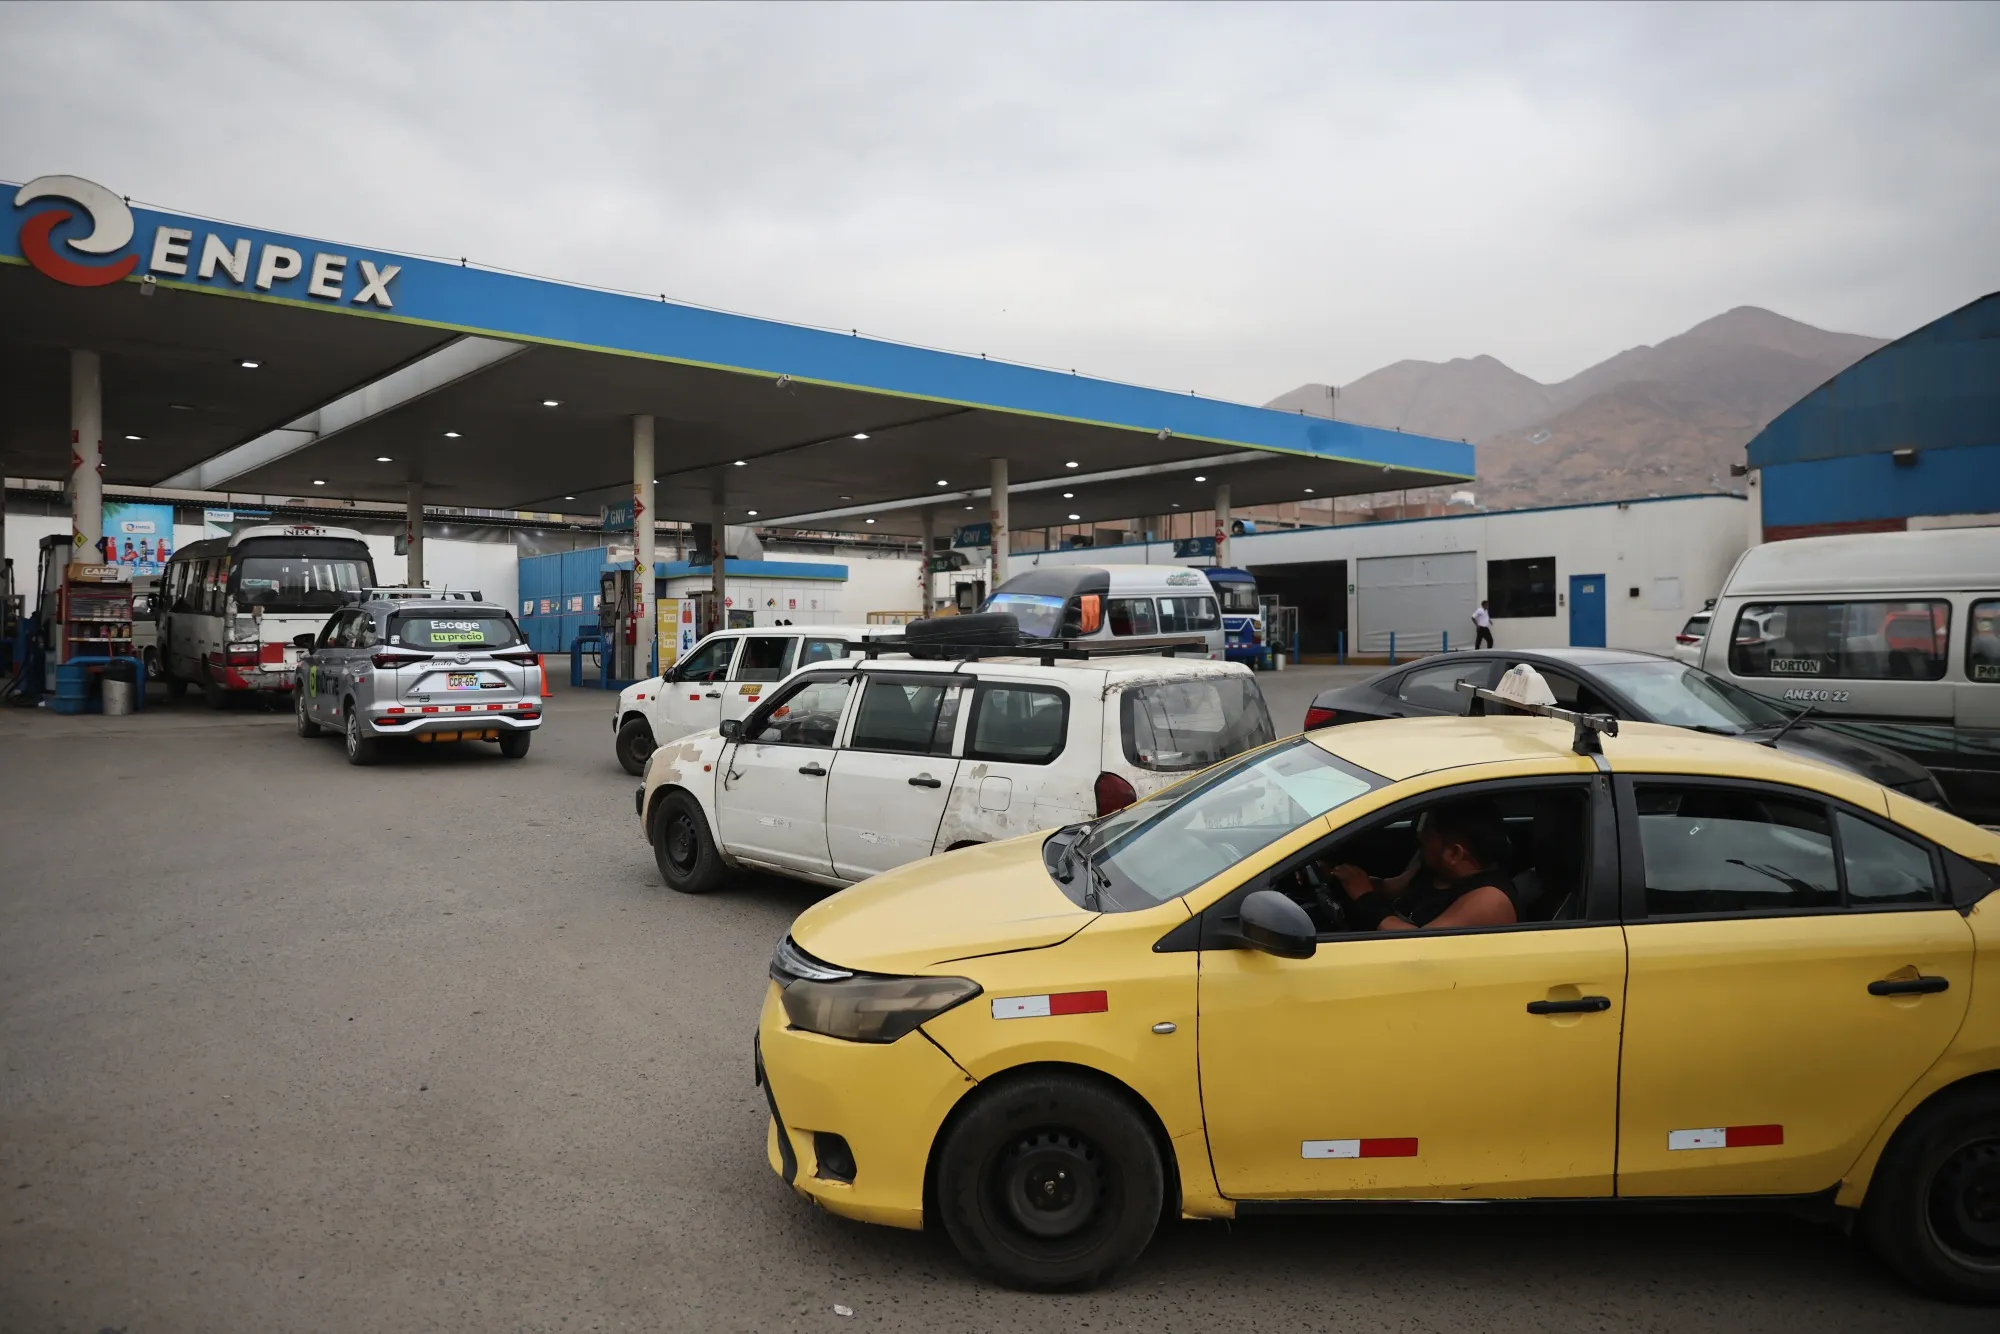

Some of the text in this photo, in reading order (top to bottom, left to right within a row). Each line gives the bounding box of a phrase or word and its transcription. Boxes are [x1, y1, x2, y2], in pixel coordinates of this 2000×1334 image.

[149, 225, 402, 309] ENPEX
[610, 507, 626, 526] GNV
[963, 529, 980, 544] GNV
[84, 568, 118, 576] CAM2
[430, 620, 480, 631] Escoge
[433, 633, 482, 643] tu precio
[1772, 660, 1819, 672] PORTON
[448, 676, 479, 687] CCR-657
[1783, 688, 1850, 702] ANEXO 22
